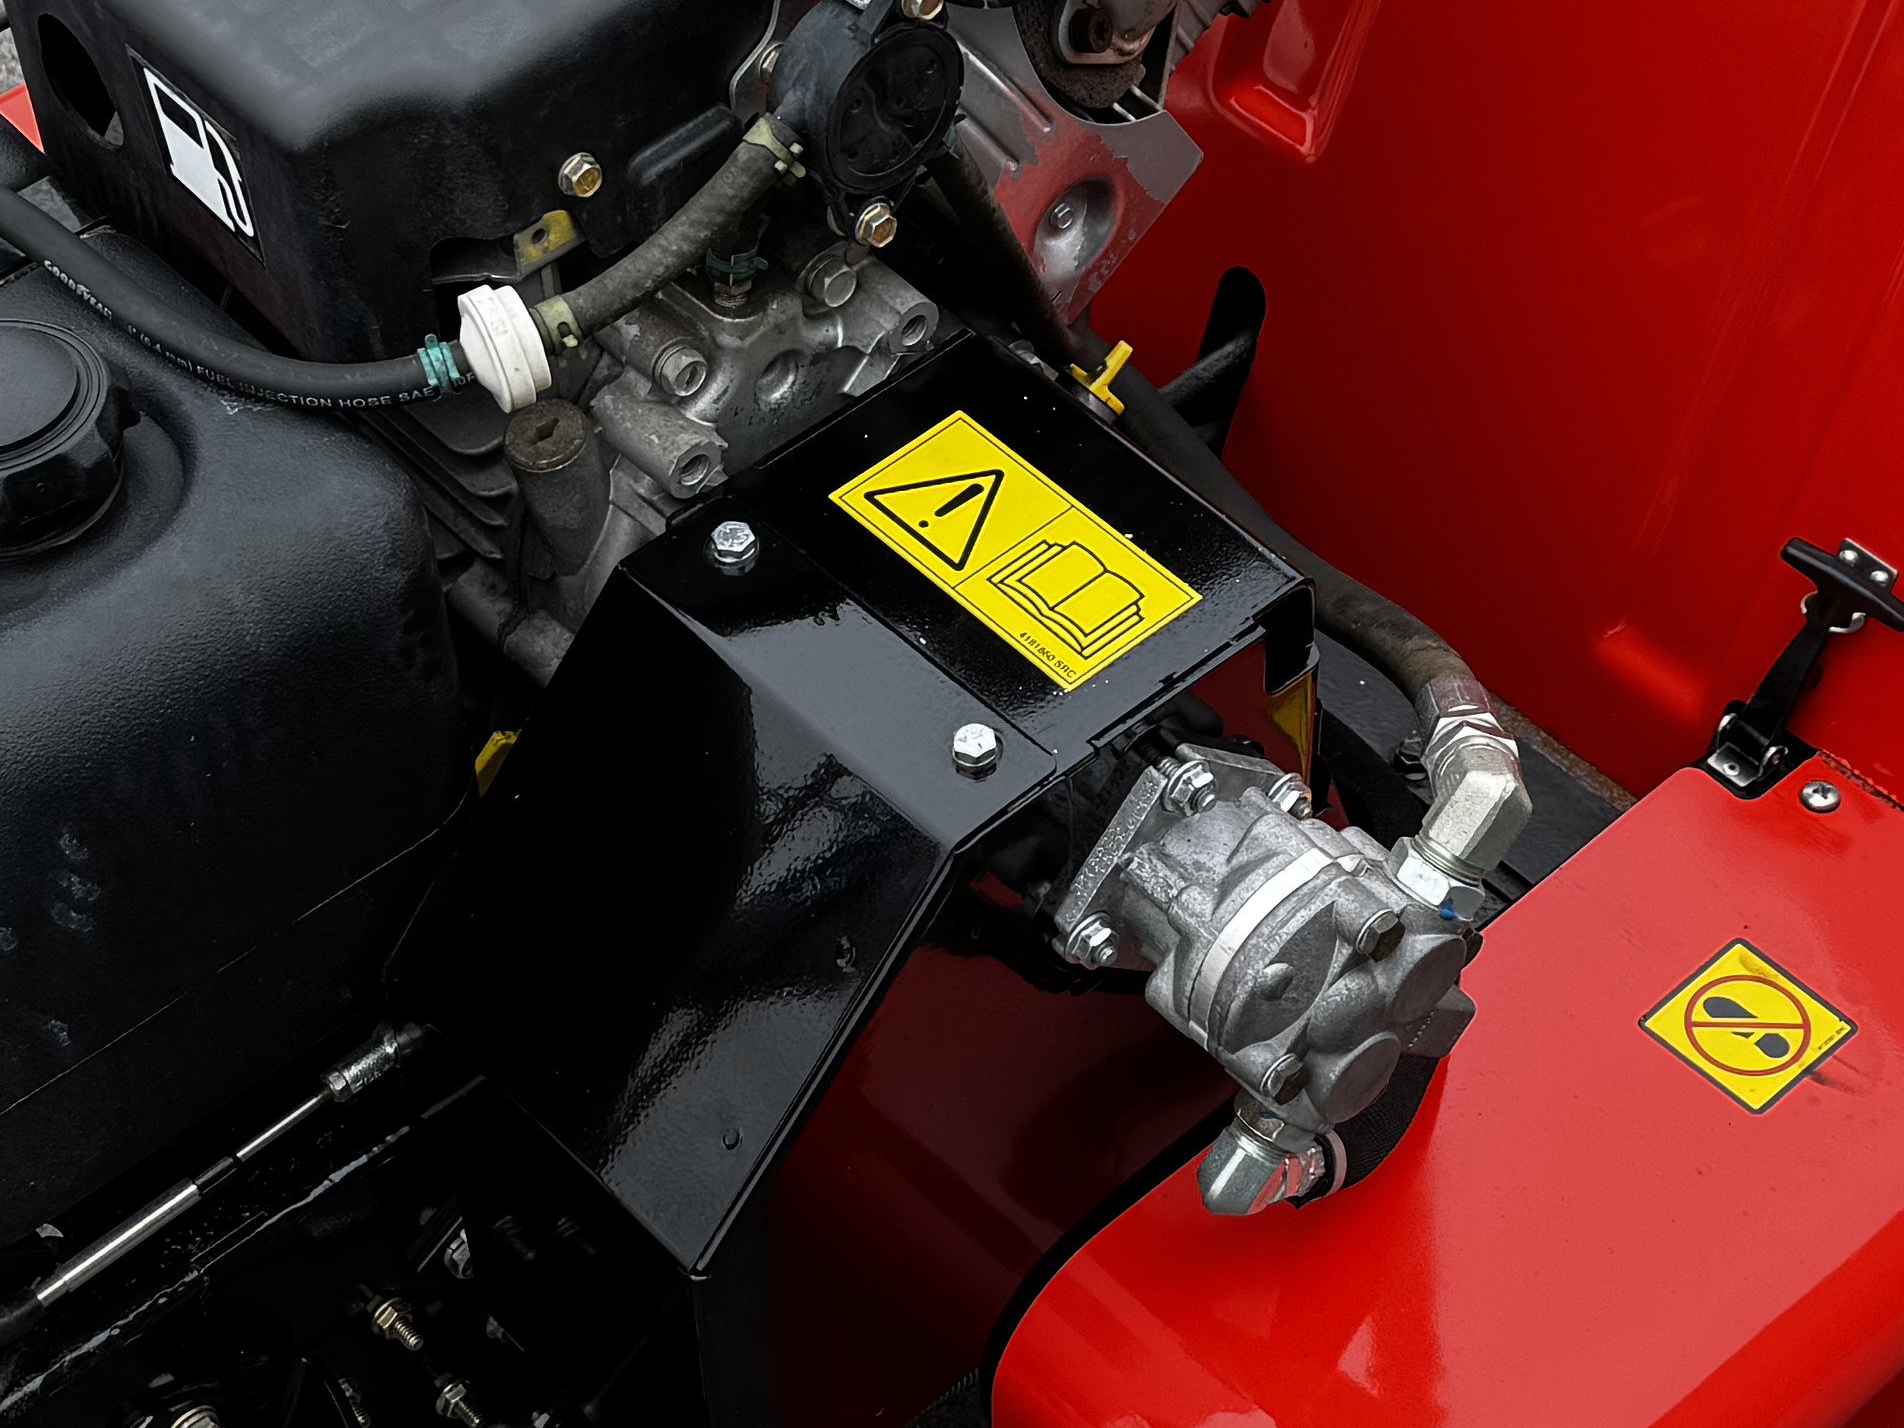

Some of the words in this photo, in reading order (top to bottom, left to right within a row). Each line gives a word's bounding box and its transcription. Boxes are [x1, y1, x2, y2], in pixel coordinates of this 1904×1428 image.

[196, 365, 235, 389] FUEL
[238, 380, 332, 408] INJECTION
[338, 394, 392, 409] HOSE
